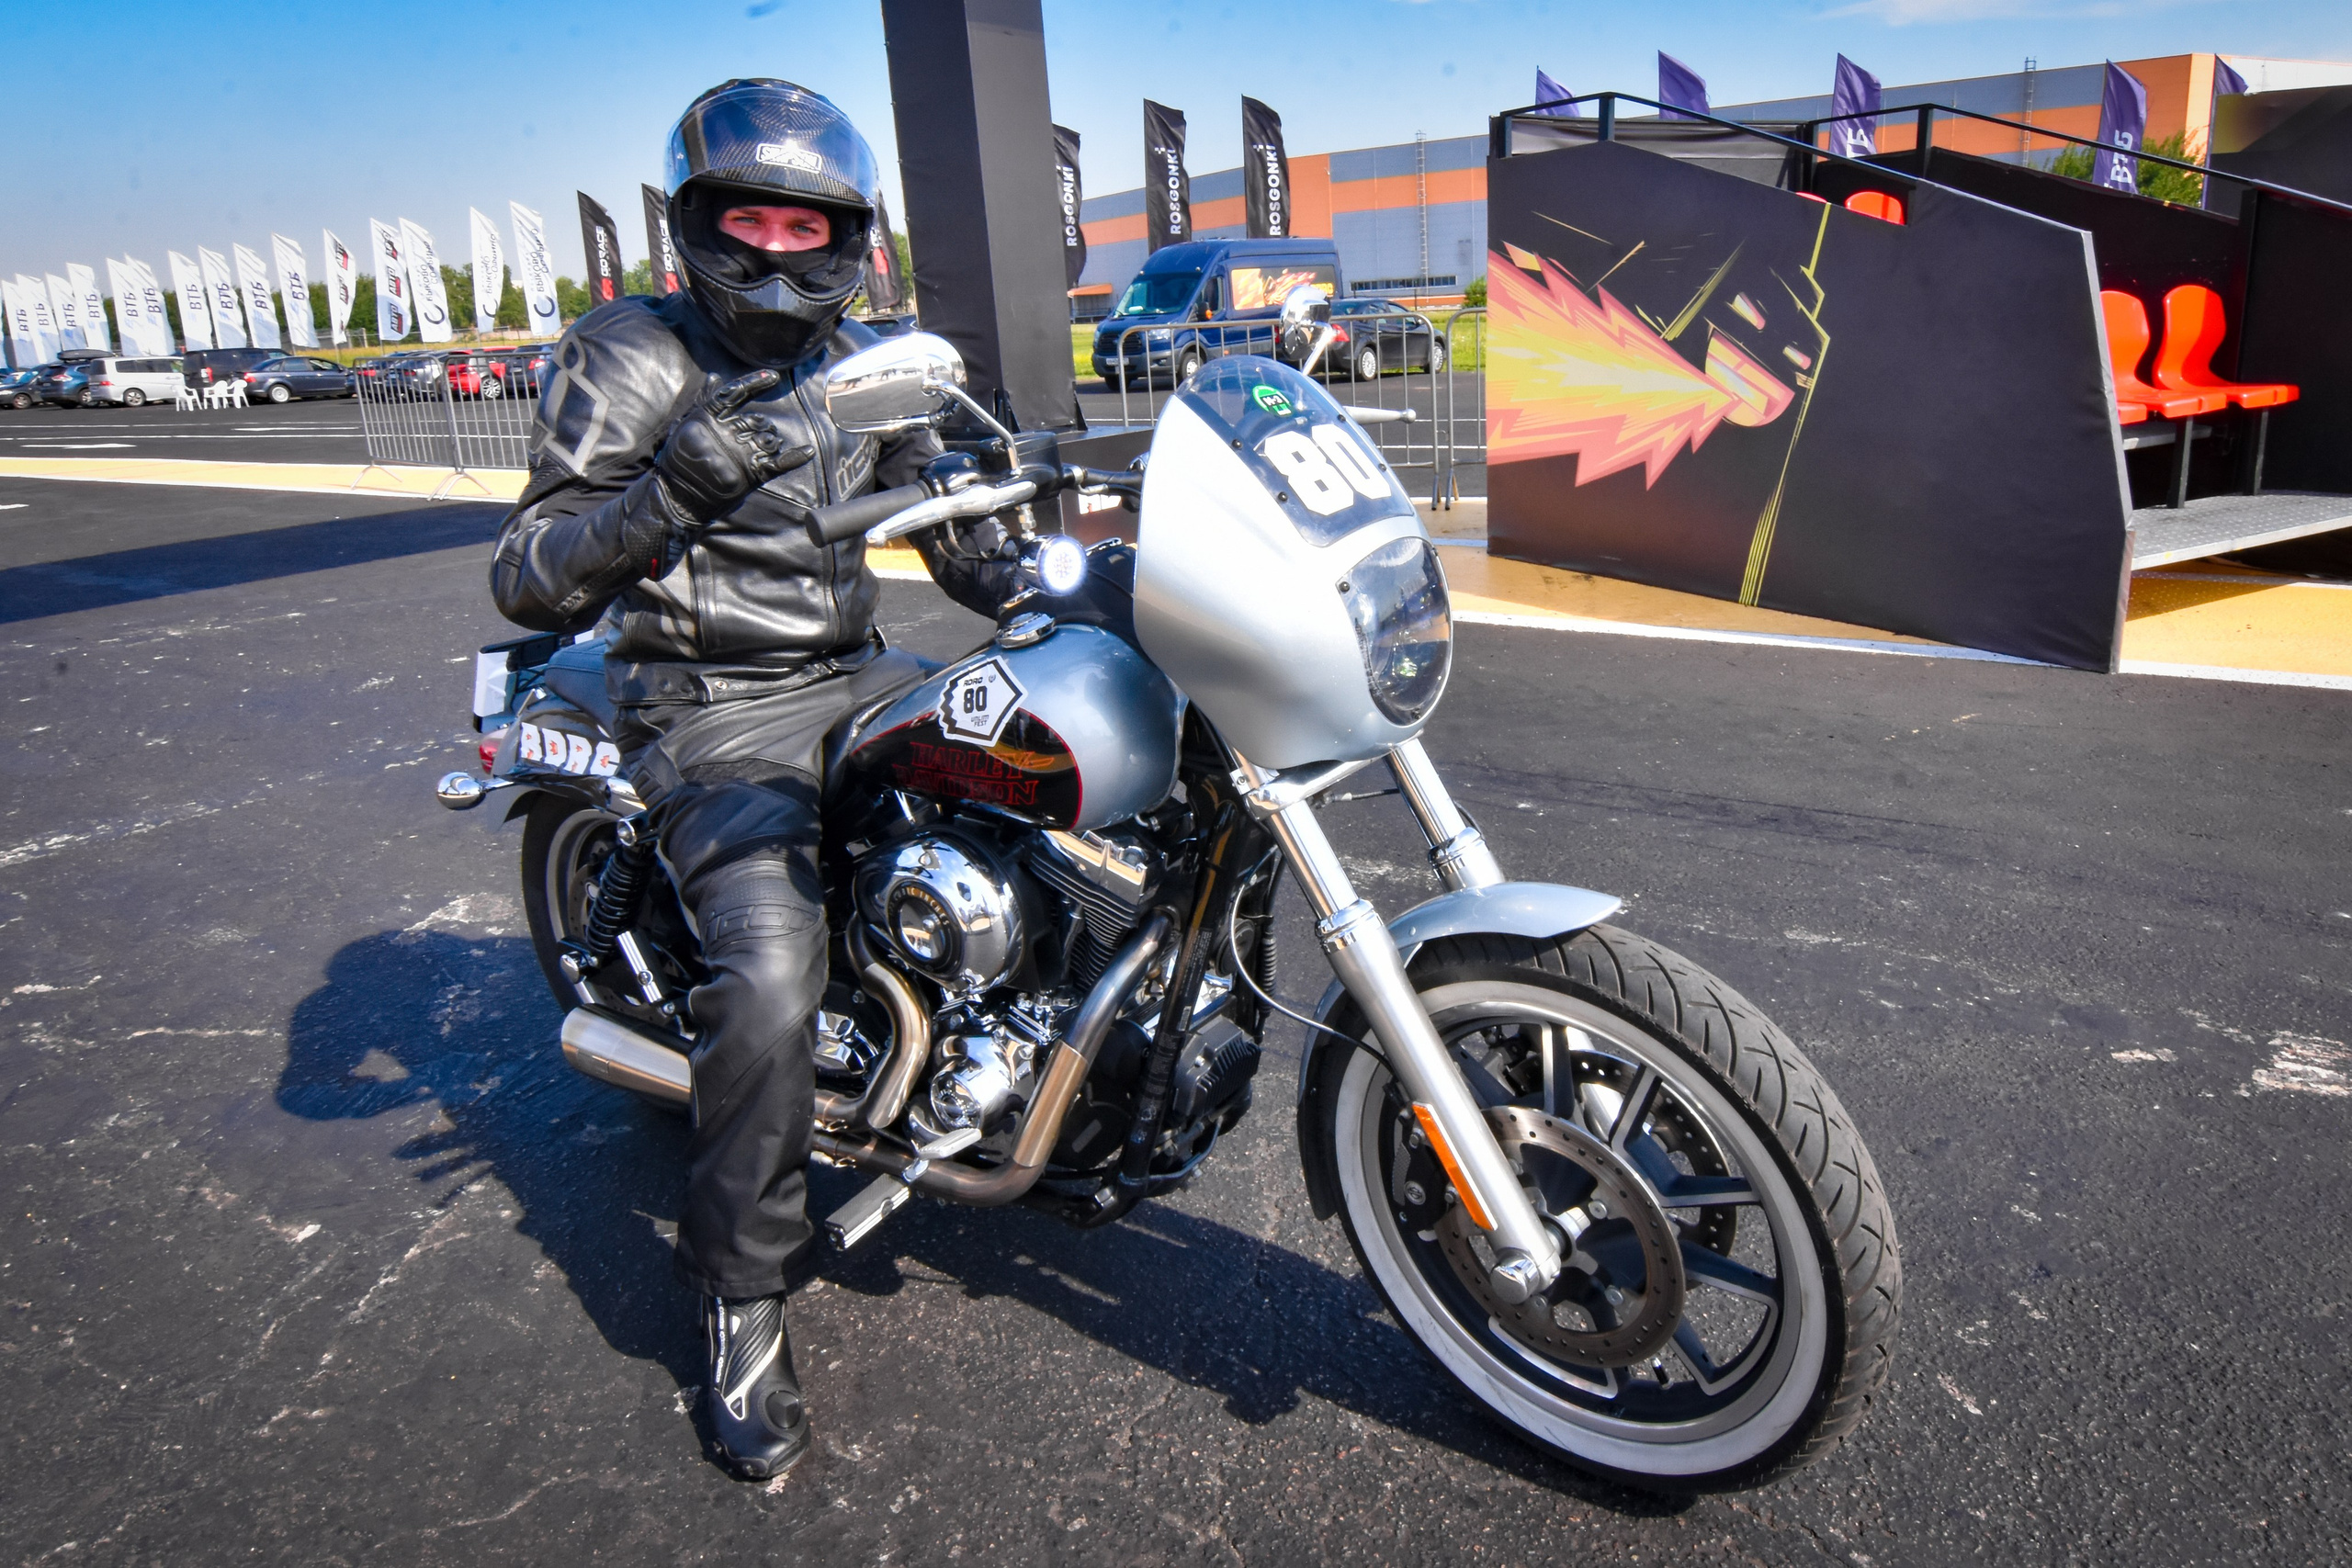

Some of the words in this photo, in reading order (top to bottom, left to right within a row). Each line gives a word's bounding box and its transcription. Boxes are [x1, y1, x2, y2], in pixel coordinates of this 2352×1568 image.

[1846, 127, 1869, 159] ТБ
[1166, 148, 1182, 234] ROSGONKI
[1261, 144, 1282, 236] ROSGONKI
[1062, 165, 1078, 247] ROSGONKI
[186, 283, 202, 310] ВТБ
[216, 281, 233, 310] ВТБ
[251, 281, 268, 310] ВТБ
[288, 271, 306, 300] ВТБ
[33, 301, 50, 326] ВТБ
[62, 302, 76, 328] ВТБ
[83, 293, 100, 319] ВТБ
[123, 291, 139, 318] ВТБ
[142, 288, 162, 314] ВТБ
[16, 307, 29, 332] ВТБ
[1264, 423, 1392, 516] 80
[964, 685, 988, 714] 80
[919, 890, 950, 926] INCHES
